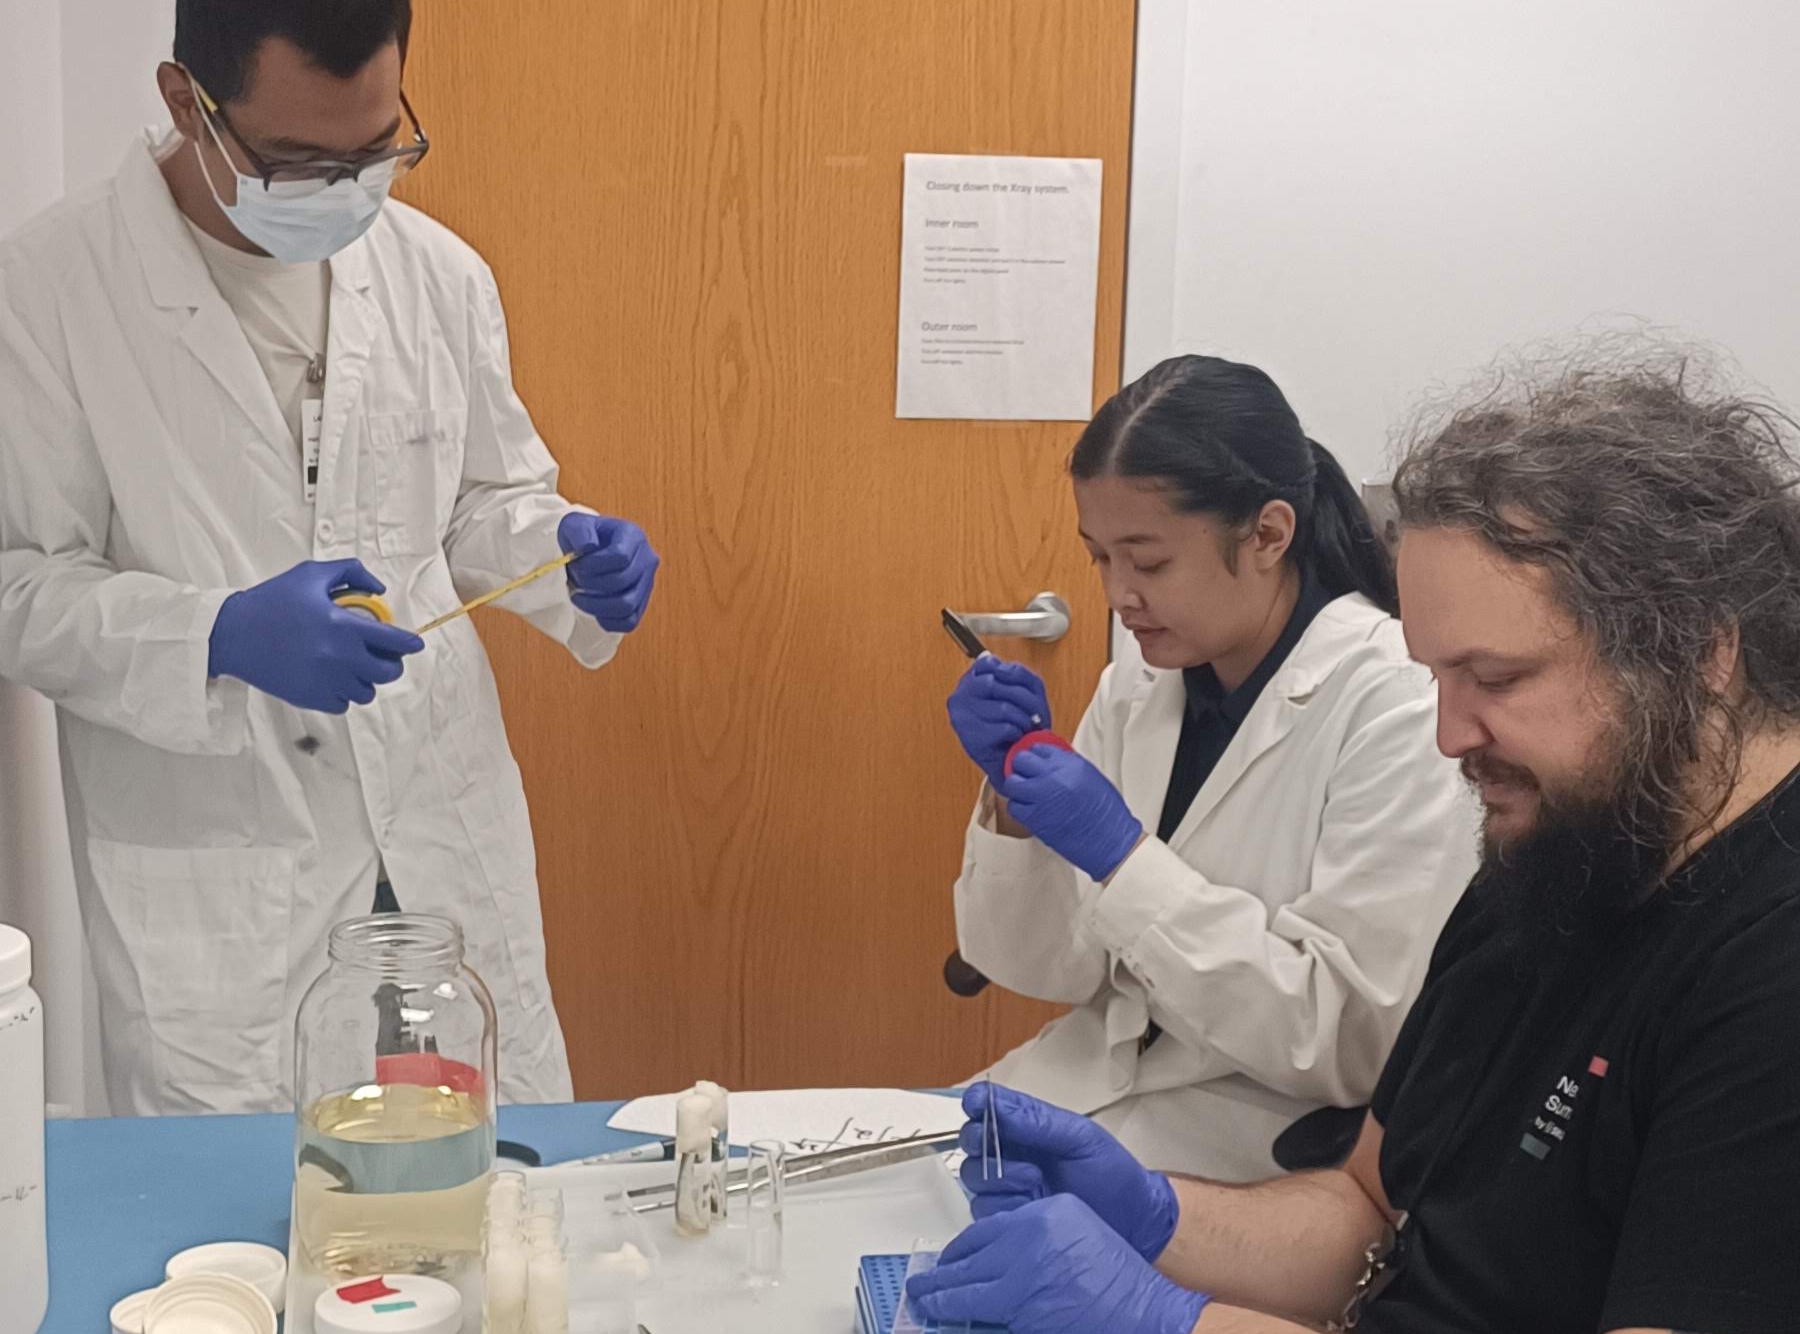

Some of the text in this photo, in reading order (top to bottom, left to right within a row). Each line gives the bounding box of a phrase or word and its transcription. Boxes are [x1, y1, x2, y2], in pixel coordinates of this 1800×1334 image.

[926, 180, 960, 193] Closing
[963, 182, 990, 192] down
[992, 183, 1008, 192] the
[1010, 183, 1032, 195] Xray
[925, 219, 950, 228] Inner
[921, 321, 978, 332] Outer room
